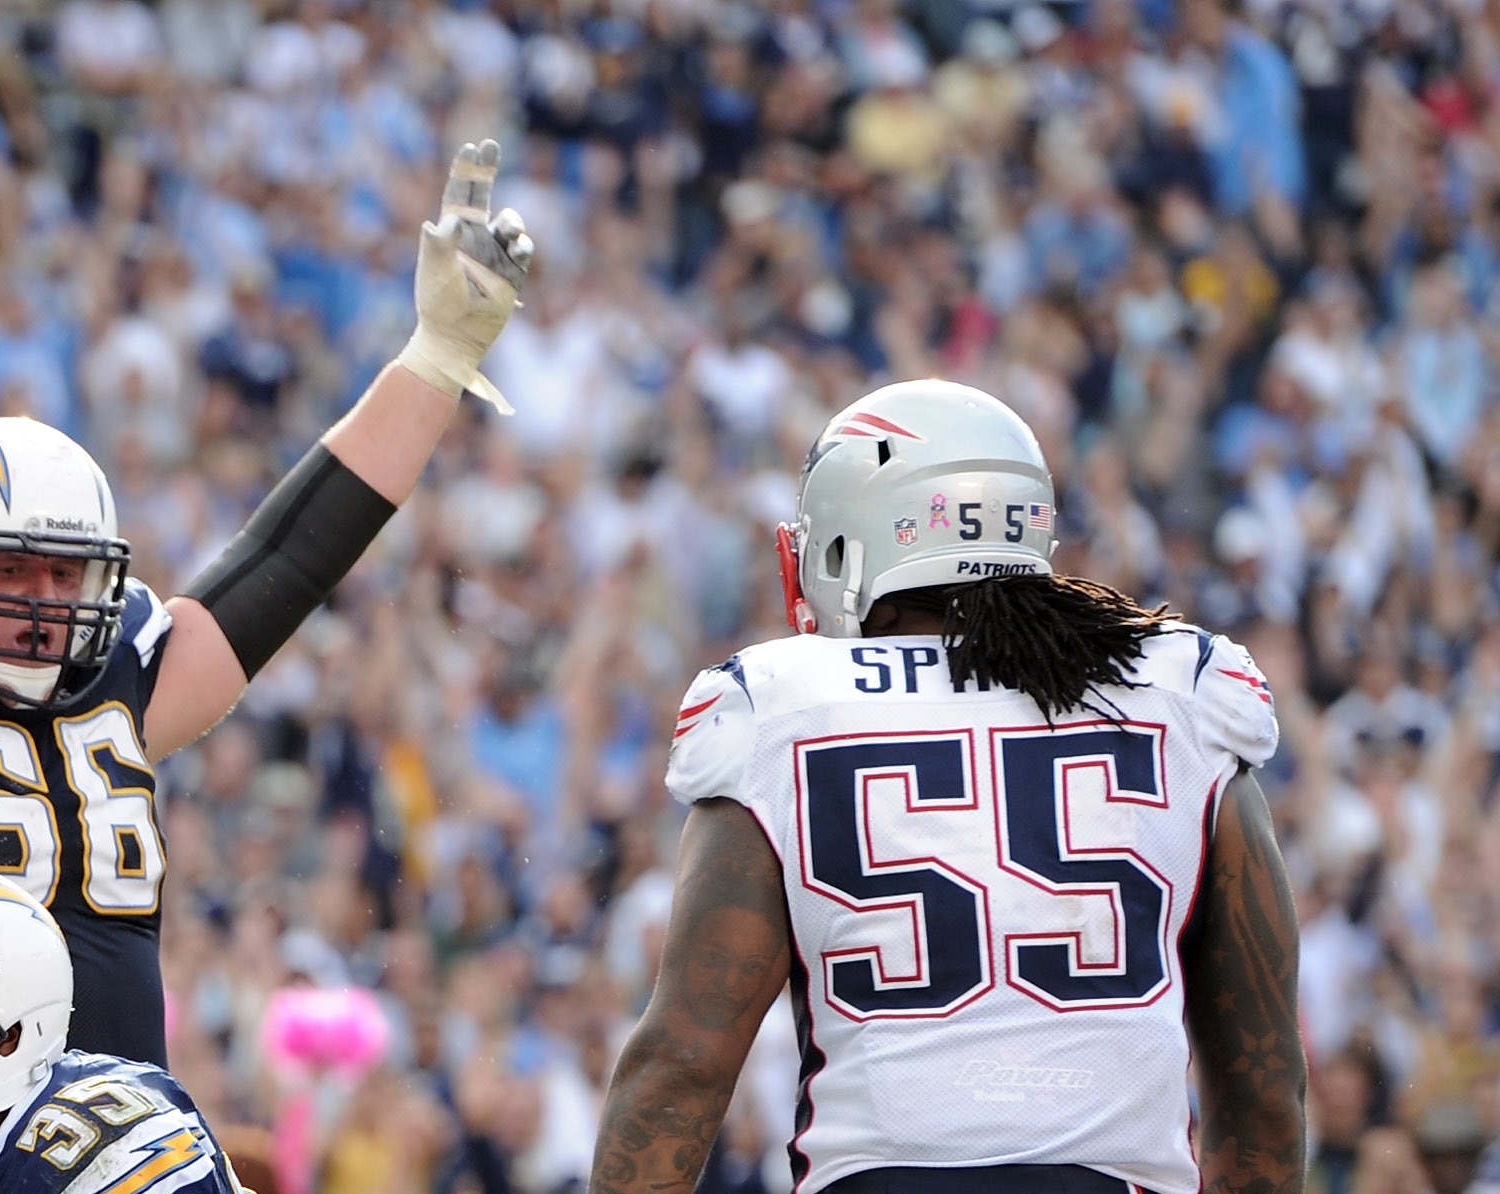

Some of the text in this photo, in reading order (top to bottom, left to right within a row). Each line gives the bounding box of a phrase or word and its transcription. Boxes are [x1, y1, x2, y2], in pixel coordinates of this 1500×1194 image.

[46, 517, 84, 532] Riddell
[794, 718, 1173, 1023] 55
[16, 1074, 157, 1172] 35
